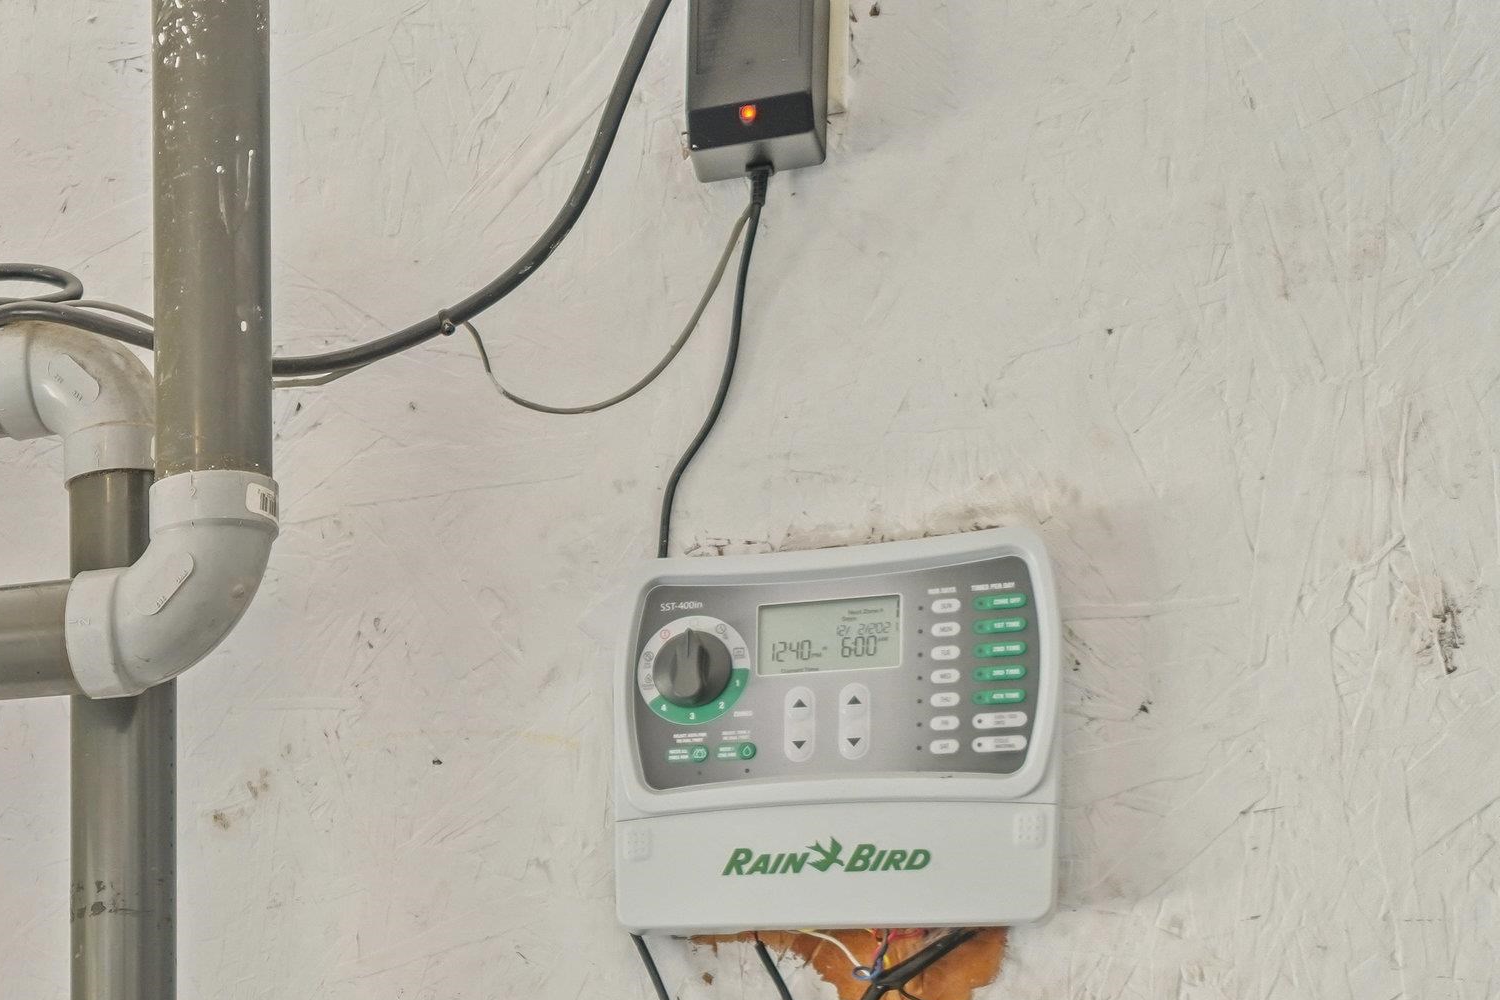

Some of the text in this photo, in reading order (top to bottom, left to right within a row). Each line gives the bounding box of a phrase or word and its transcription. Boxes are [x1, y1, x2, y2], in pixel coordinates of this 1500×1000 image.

[660, 601, 704, 612] SST-400in
[841, 635, 877, 658] 6:00
[735, 679, 740, 687] 1
[718, 701, 725, 709] 2
[689, 712, 696, 720] 3
[722, 843, 931, 876] RAIN BIRD
